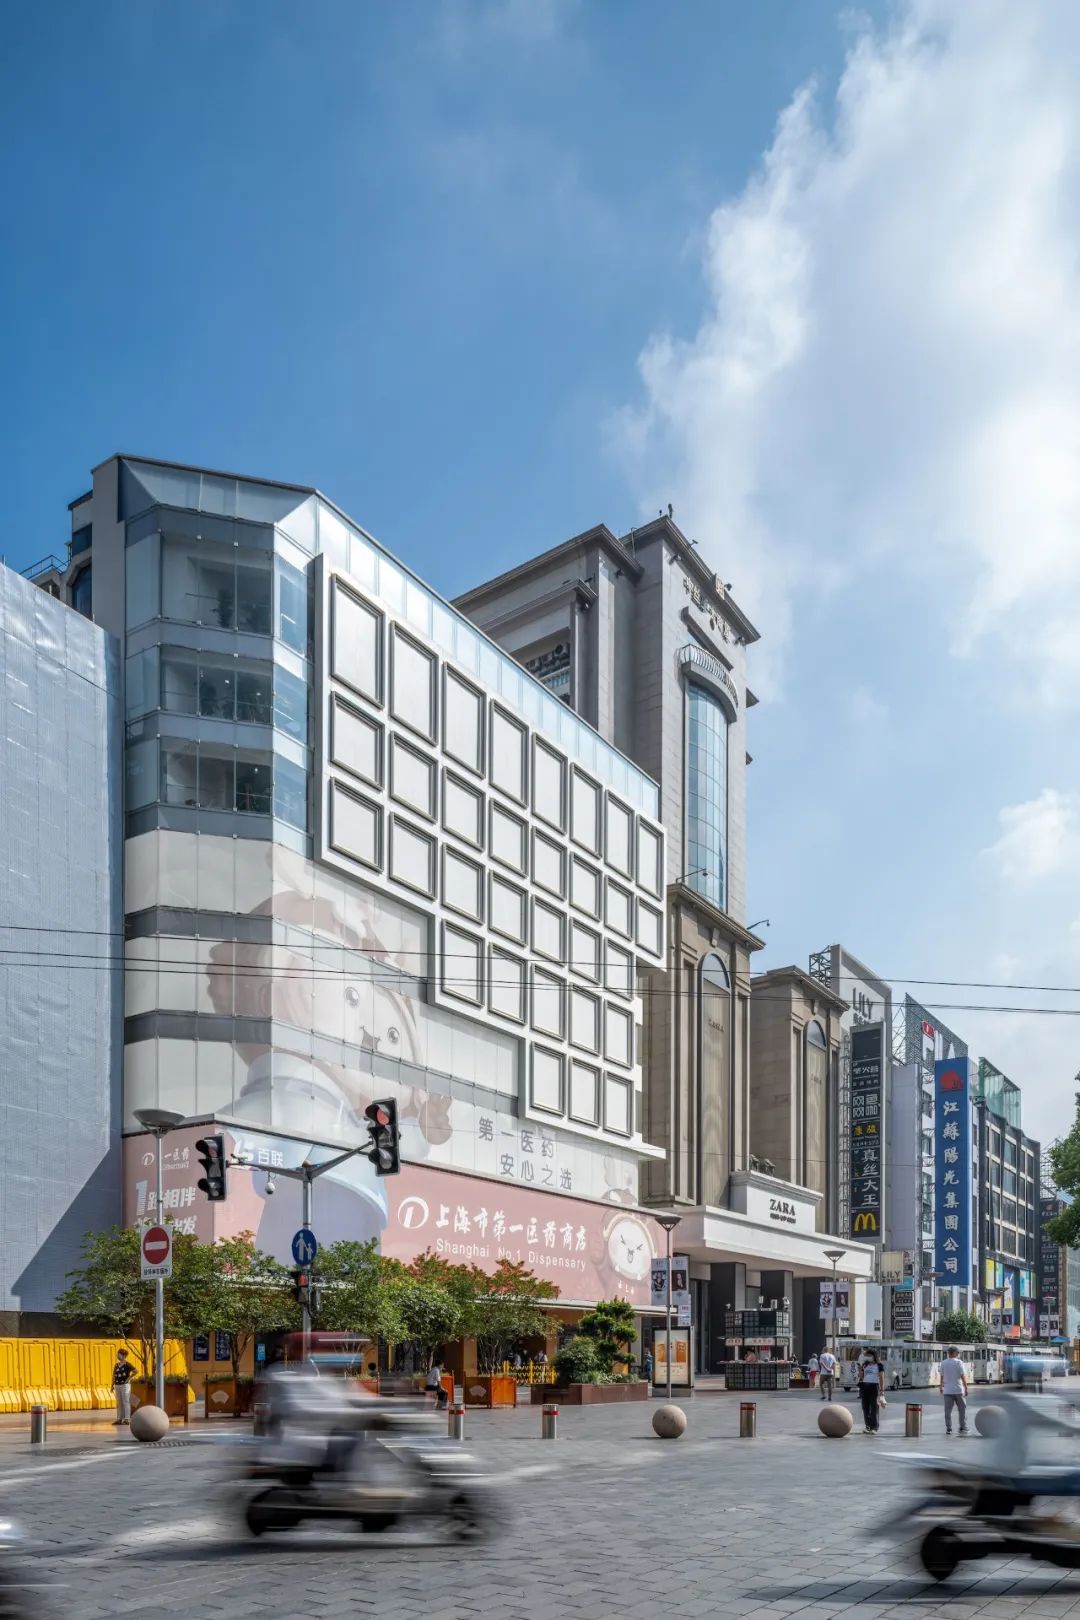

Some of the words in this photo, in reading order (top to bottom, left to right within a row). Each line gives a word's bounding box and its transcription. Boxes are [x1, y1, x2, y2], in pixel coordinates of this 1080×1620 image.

[853, 987, 874, 1020] LILY
[478, 1115, 555, 1159] 第一医药
[258, 1148, 283, 1167] 百联
[500, 1153, 572, 1190] 安心之选
[861, 1149, 879, 1207] 真丝大王
[943, 1101, 960, 1274] 江蘇陽光集團公司
[770, 1199, 796, 1216] ZARA
[436, 1204, 587, 1252] 上海市第一医药商店
[436, 1238, 490, 1259] Shanghai
[498, 1247, 522, 1262] No.1
[528, 1250, 587, 1272] Dispensary
[881, 1271, 900, 1280] LILY
